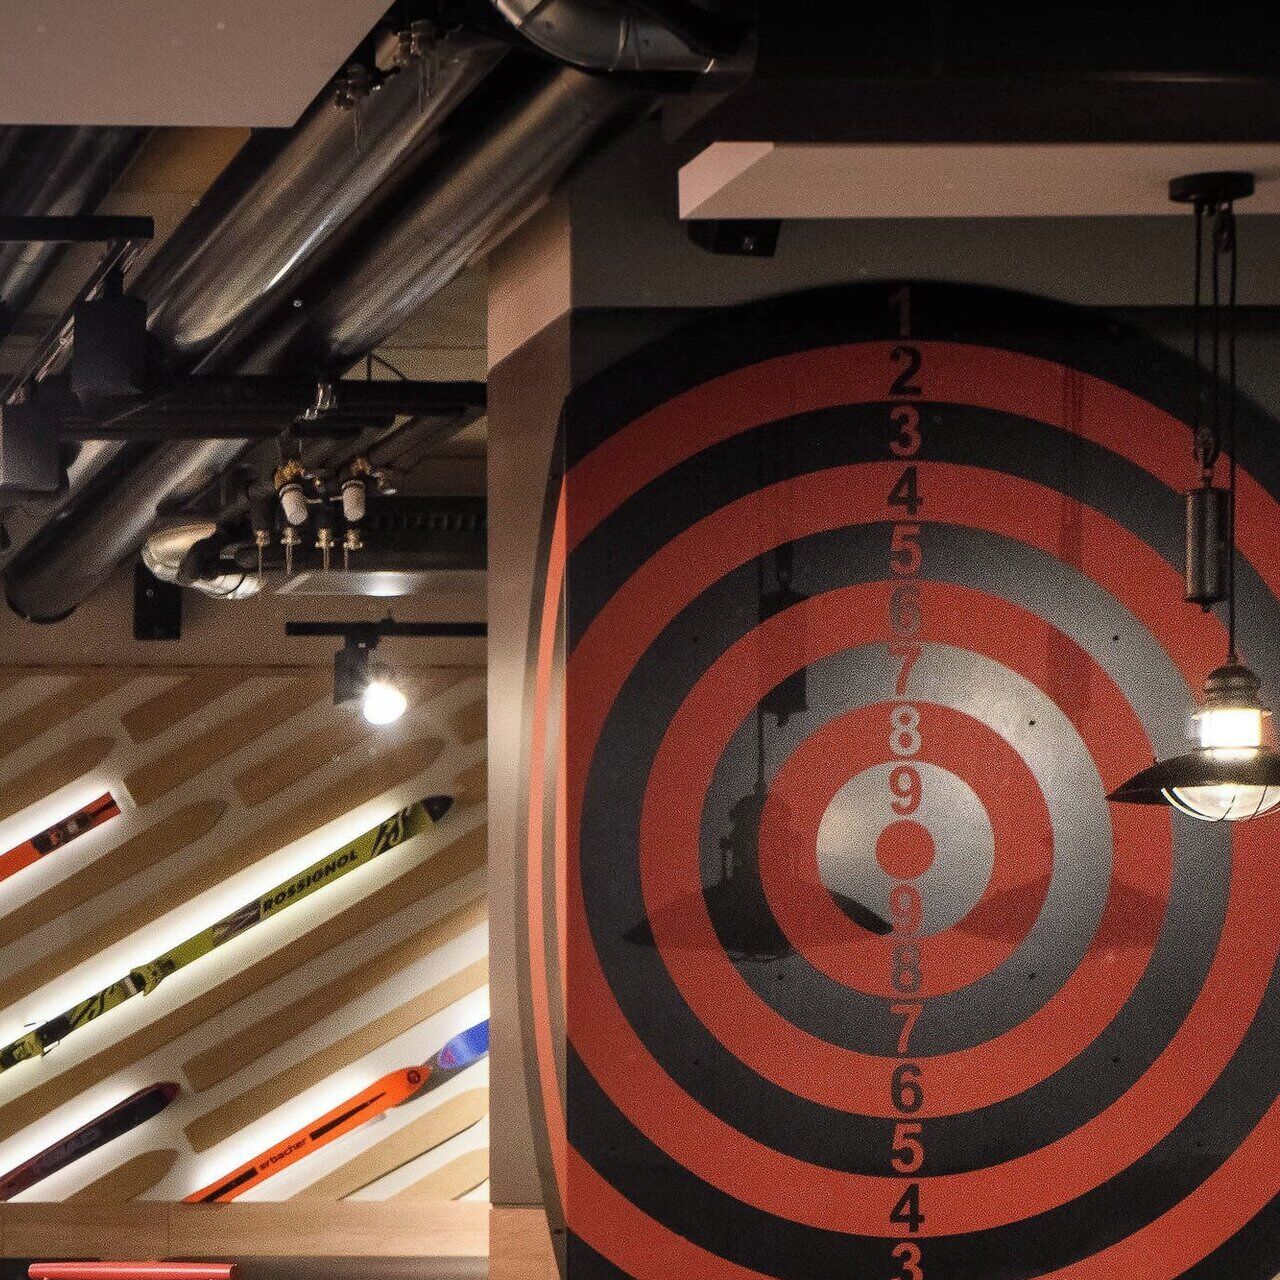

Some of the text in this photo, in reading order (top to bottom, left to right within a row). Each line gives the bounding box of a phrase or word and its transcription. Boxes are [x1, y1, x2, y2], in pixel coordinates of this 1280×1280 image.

[888, 285, 911, 338] 1
[890, 346, 922, 395] 2
[890, 405, 921, 457] 3
[888, 465, 922, 515] 4
[890, 525, 922, 575] 5
[890, 585, 922, 636] 6
[889, 648, 923, 695] 7
[890, 705, 921, 756] 8
[890, 765, 922, 815] 9
[890, 885, 923, 935] 9
[892, 944, 922, 993] 8
[890, 1004, 923, 1054] 7
[891, 1063, 924, 1113] 6
[891, 1123, 925, 1173] 5
[890, 1183, 925, 1233] 4
